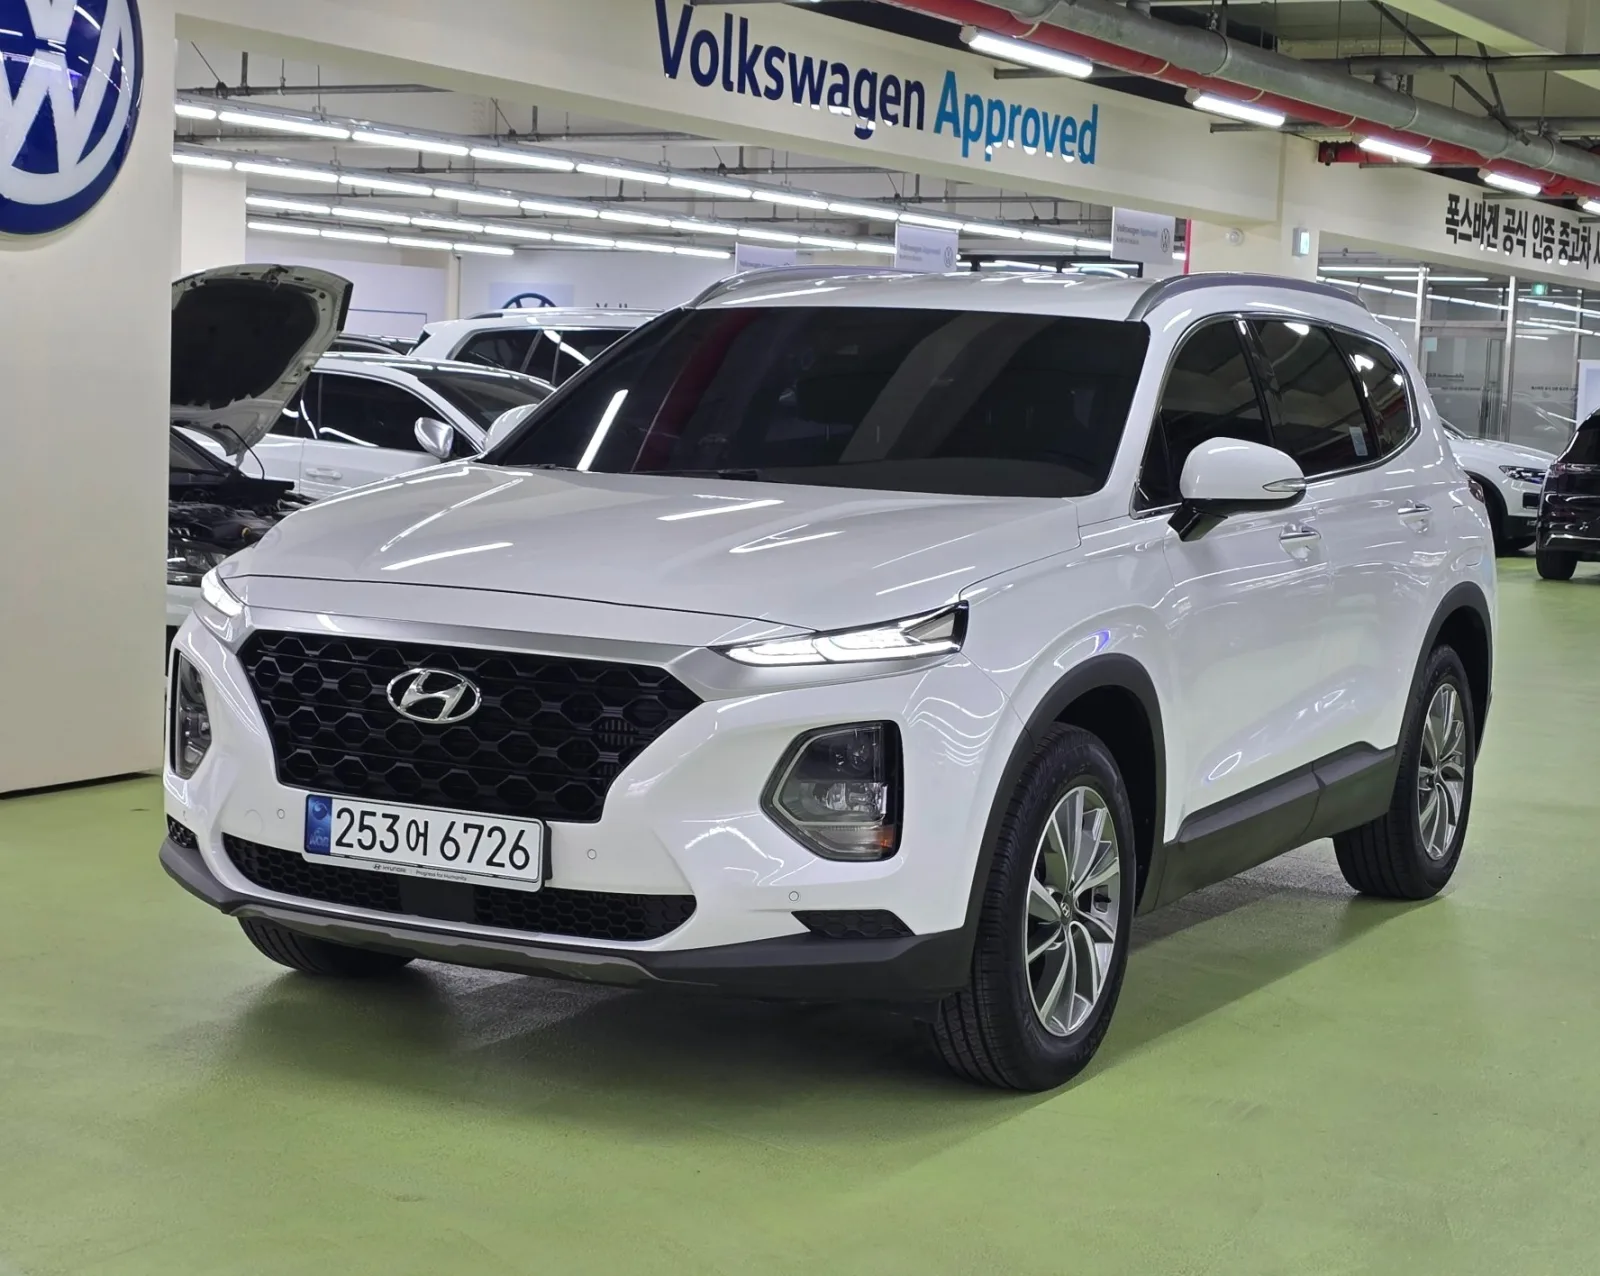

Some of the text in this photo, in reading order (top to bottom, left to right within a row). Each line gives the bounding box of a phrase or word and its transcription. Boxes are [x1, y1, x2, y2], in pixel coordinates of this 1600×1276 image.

[655, 0, 1098, 164] Volkswagen Approved
[1445, 193, 1500, 252] 폭스바겐
[1503, 207, 1528, 258] 공식
[1532, 214, 1555, 264] 인증
[1558, 221, 1591, 270] 중고차
[335, 807, 530, 870] 253어 6726
[415, 869, 436, 877] Progress
